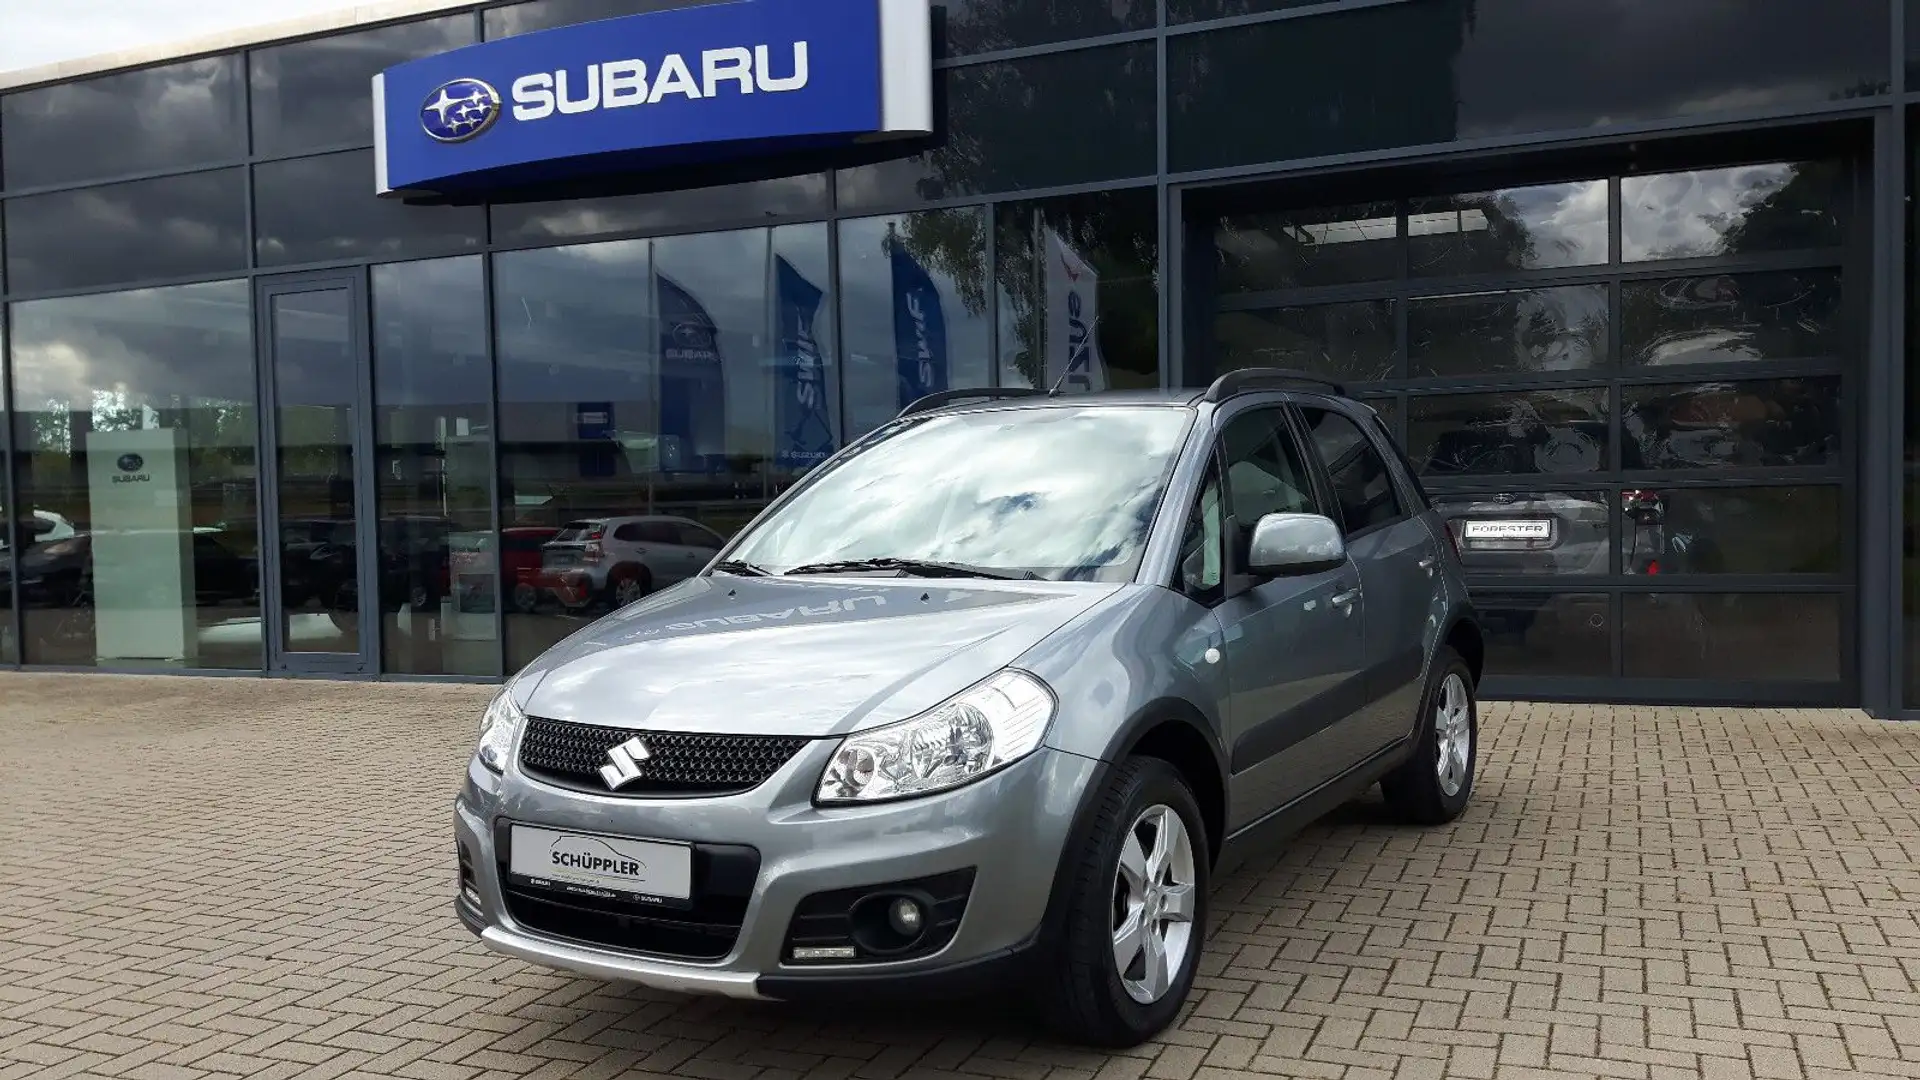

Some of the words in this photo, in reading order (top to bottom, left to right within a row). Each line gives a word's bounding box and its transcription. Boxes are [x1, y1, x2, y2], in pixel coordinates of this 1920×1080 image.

[512, 41, 809, 122] SUBARU
[112, 474, 150, 484] SUBARU
[1472, 524, 1543, 533] FORESTER
[552, 851, 639, 876] SCHÜPPLER
